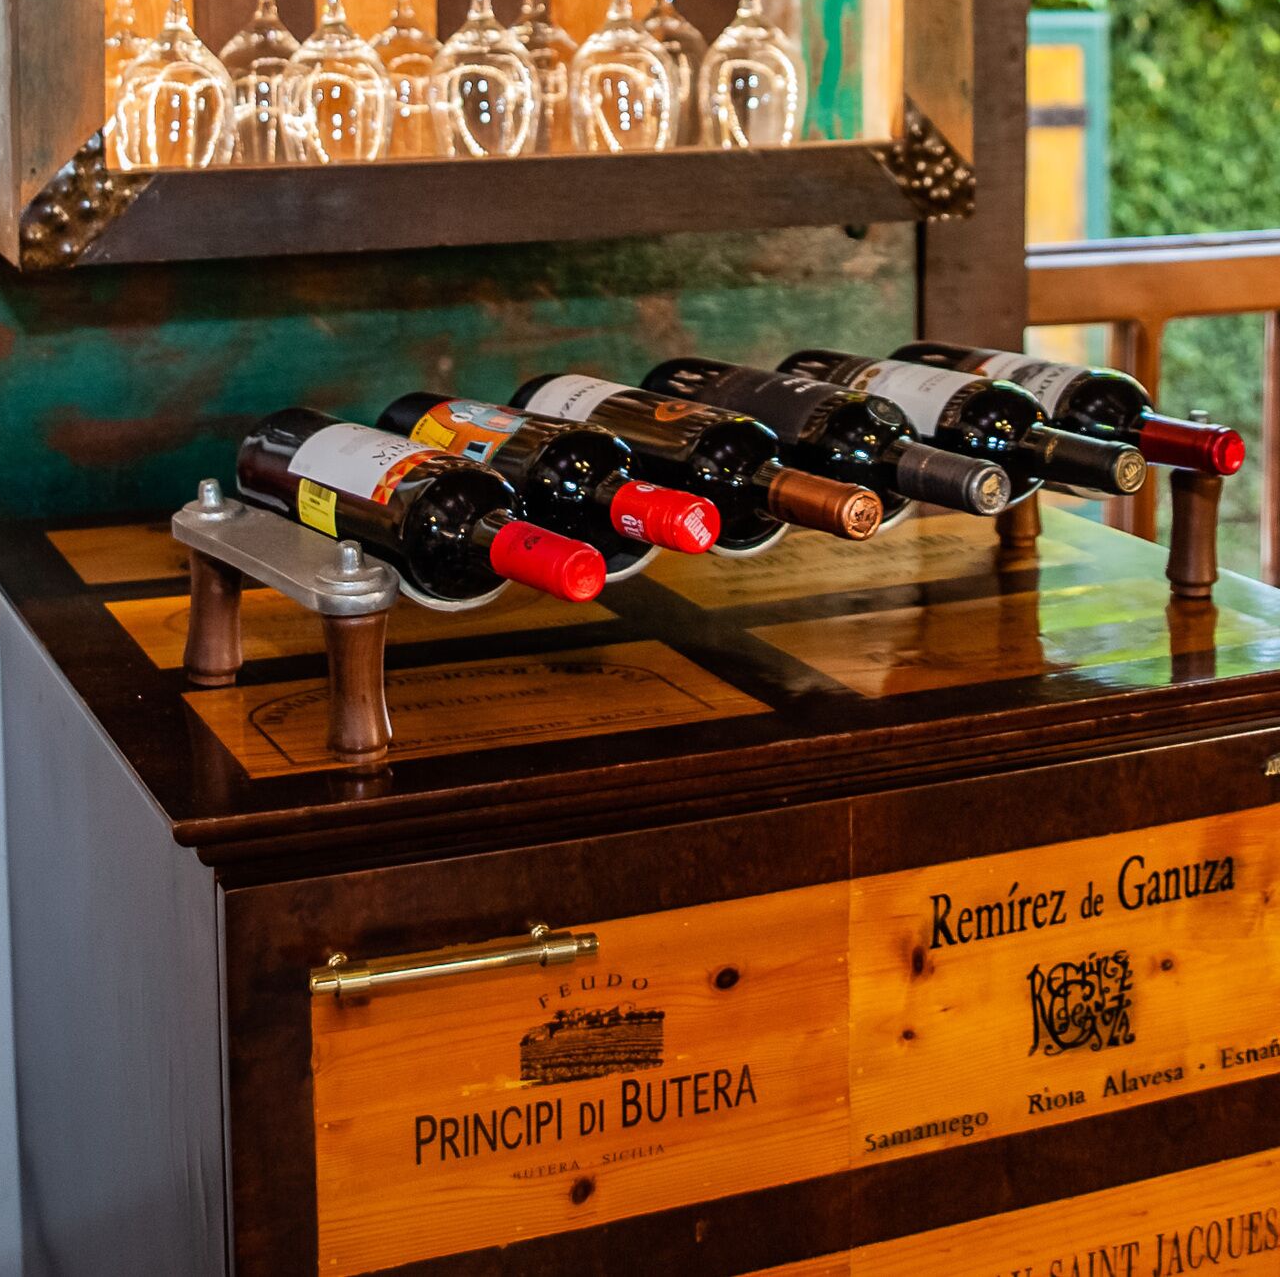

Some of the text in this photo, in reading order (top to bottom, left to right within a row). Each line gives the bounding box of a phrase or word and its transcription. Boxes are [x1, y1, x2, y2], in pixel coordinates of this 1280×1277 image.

[683, 511, 713, 548] GUAPO
[929, 854, 1236, 950] Remírez de Ganuza
[537, 972, 651, 1010] FEUDO
[1101, 1064, 1185, 1099] Alavesa
[414, 1064, 758, 1166] PRINCIPI DI BUTERA
[601, 1143, 666, 1165] SICILIA
[1152, 1207, 1280, 1277] JACQUES
